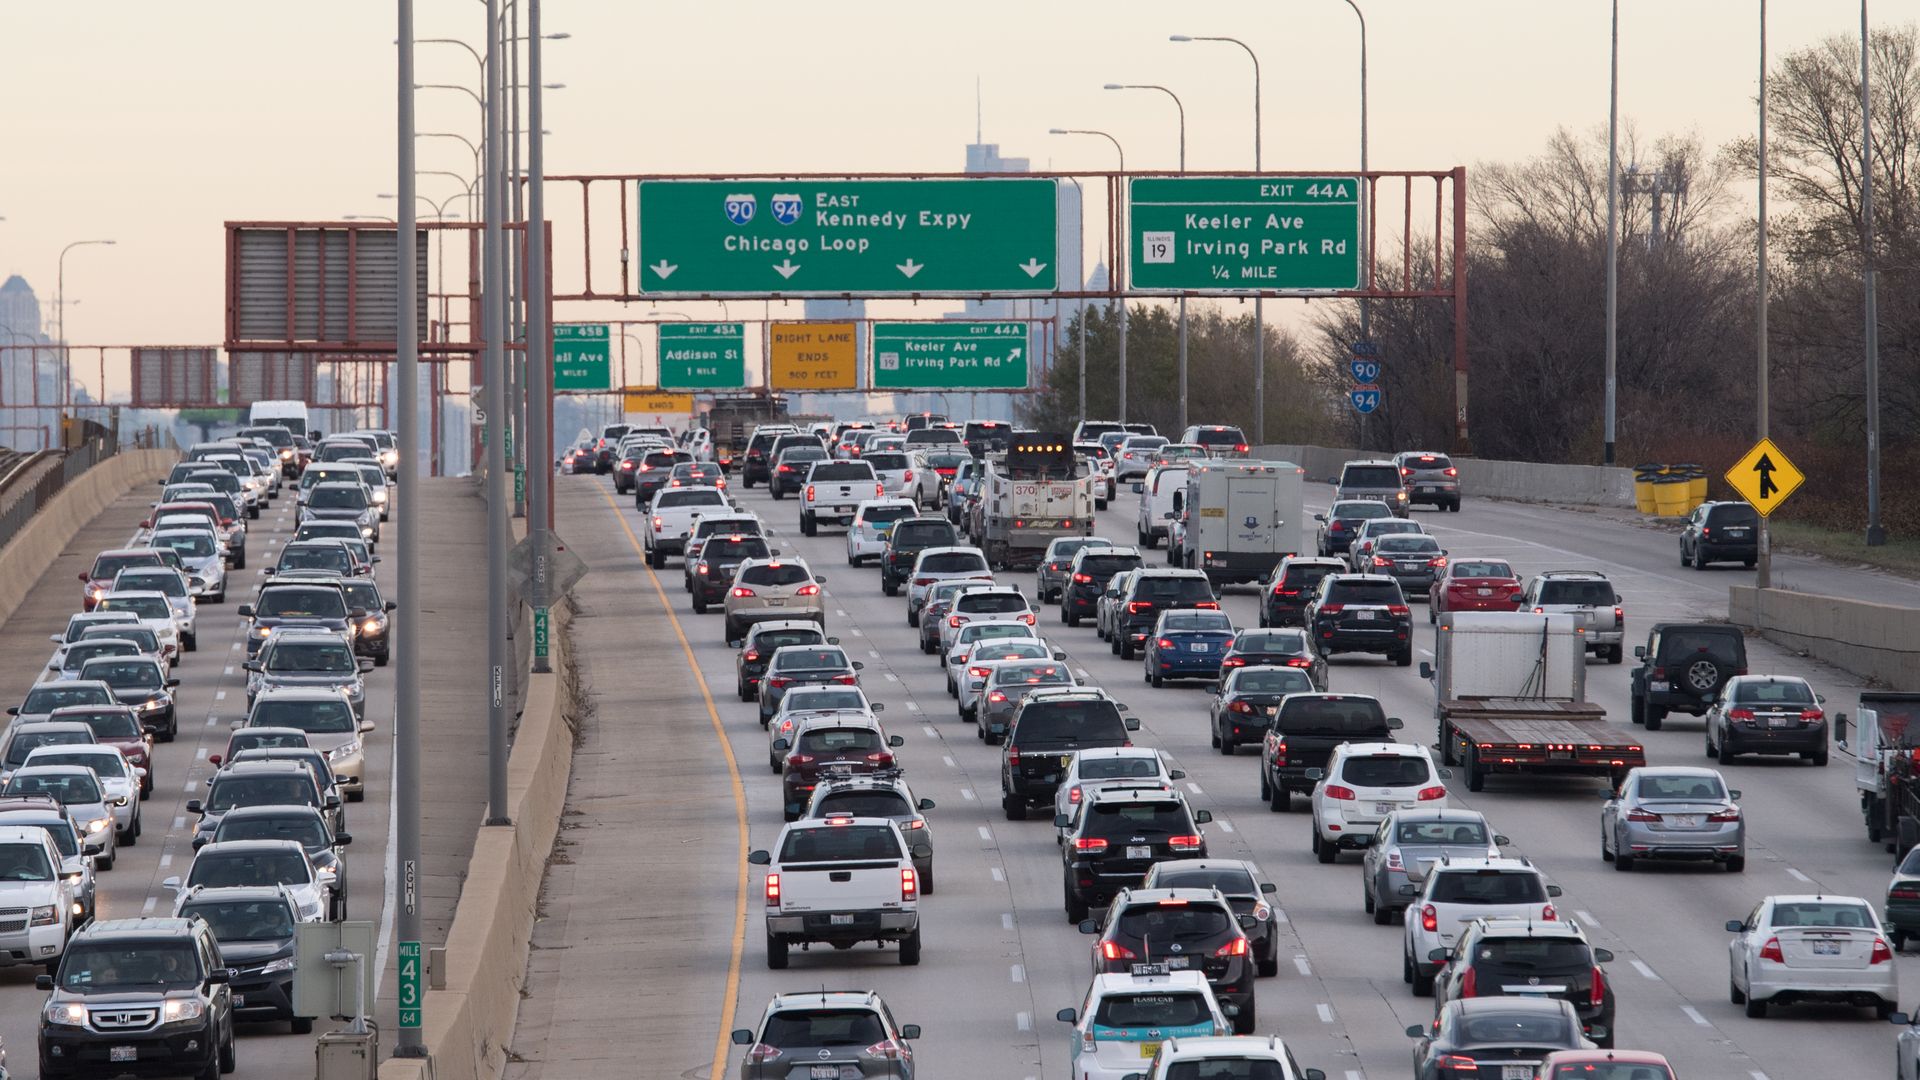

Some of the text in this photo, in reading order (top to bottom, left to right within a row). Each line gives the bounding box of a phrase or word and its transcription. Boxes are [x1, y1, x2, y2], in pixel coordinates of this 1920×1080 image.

[1261, 184, 1348, 198] EXIT 44A
[816, 193, 859, 207] EAST
[728, 202, 752, 220] 90
[775, 202, 799, 219] 94
[816, 211, 971, 229] Kennedy Expy
[1186, 214, 1304, 229] Keeler Ave
[724, 236, 869, 255] Chicago Loop
[1152, 244, 1166, 258] 19
[1187, 240, 1346, 259] Irving Park Rd
[1242, 266, 1277, 278] MILE
[578, 327, 603, 336] 45B
[713, 325, 737, 334] 45A
[994, 326, 1019, 334] 44A
[776, 334, 850, 342] RIGHT LANE
[905, 342, 977, 352] Keeler Ave
[579, 352, 603, 362] Ave
[666, 349, 737, 360] Addison St
[798, 353, 829, 361] ENDS
[905, 357, 1000, 370] Irving Park Rd
[1356, 364, 1375, 377] 90
[1355, 394, 1375, 408] 94
[1016, 486, 1035, 495] 370
[536, 617, 545, 643] 43
[400, 946, 419, 956] MILE
[402, 960, 416, 1004] 43
[402, 1012, 415, 1023] 64
